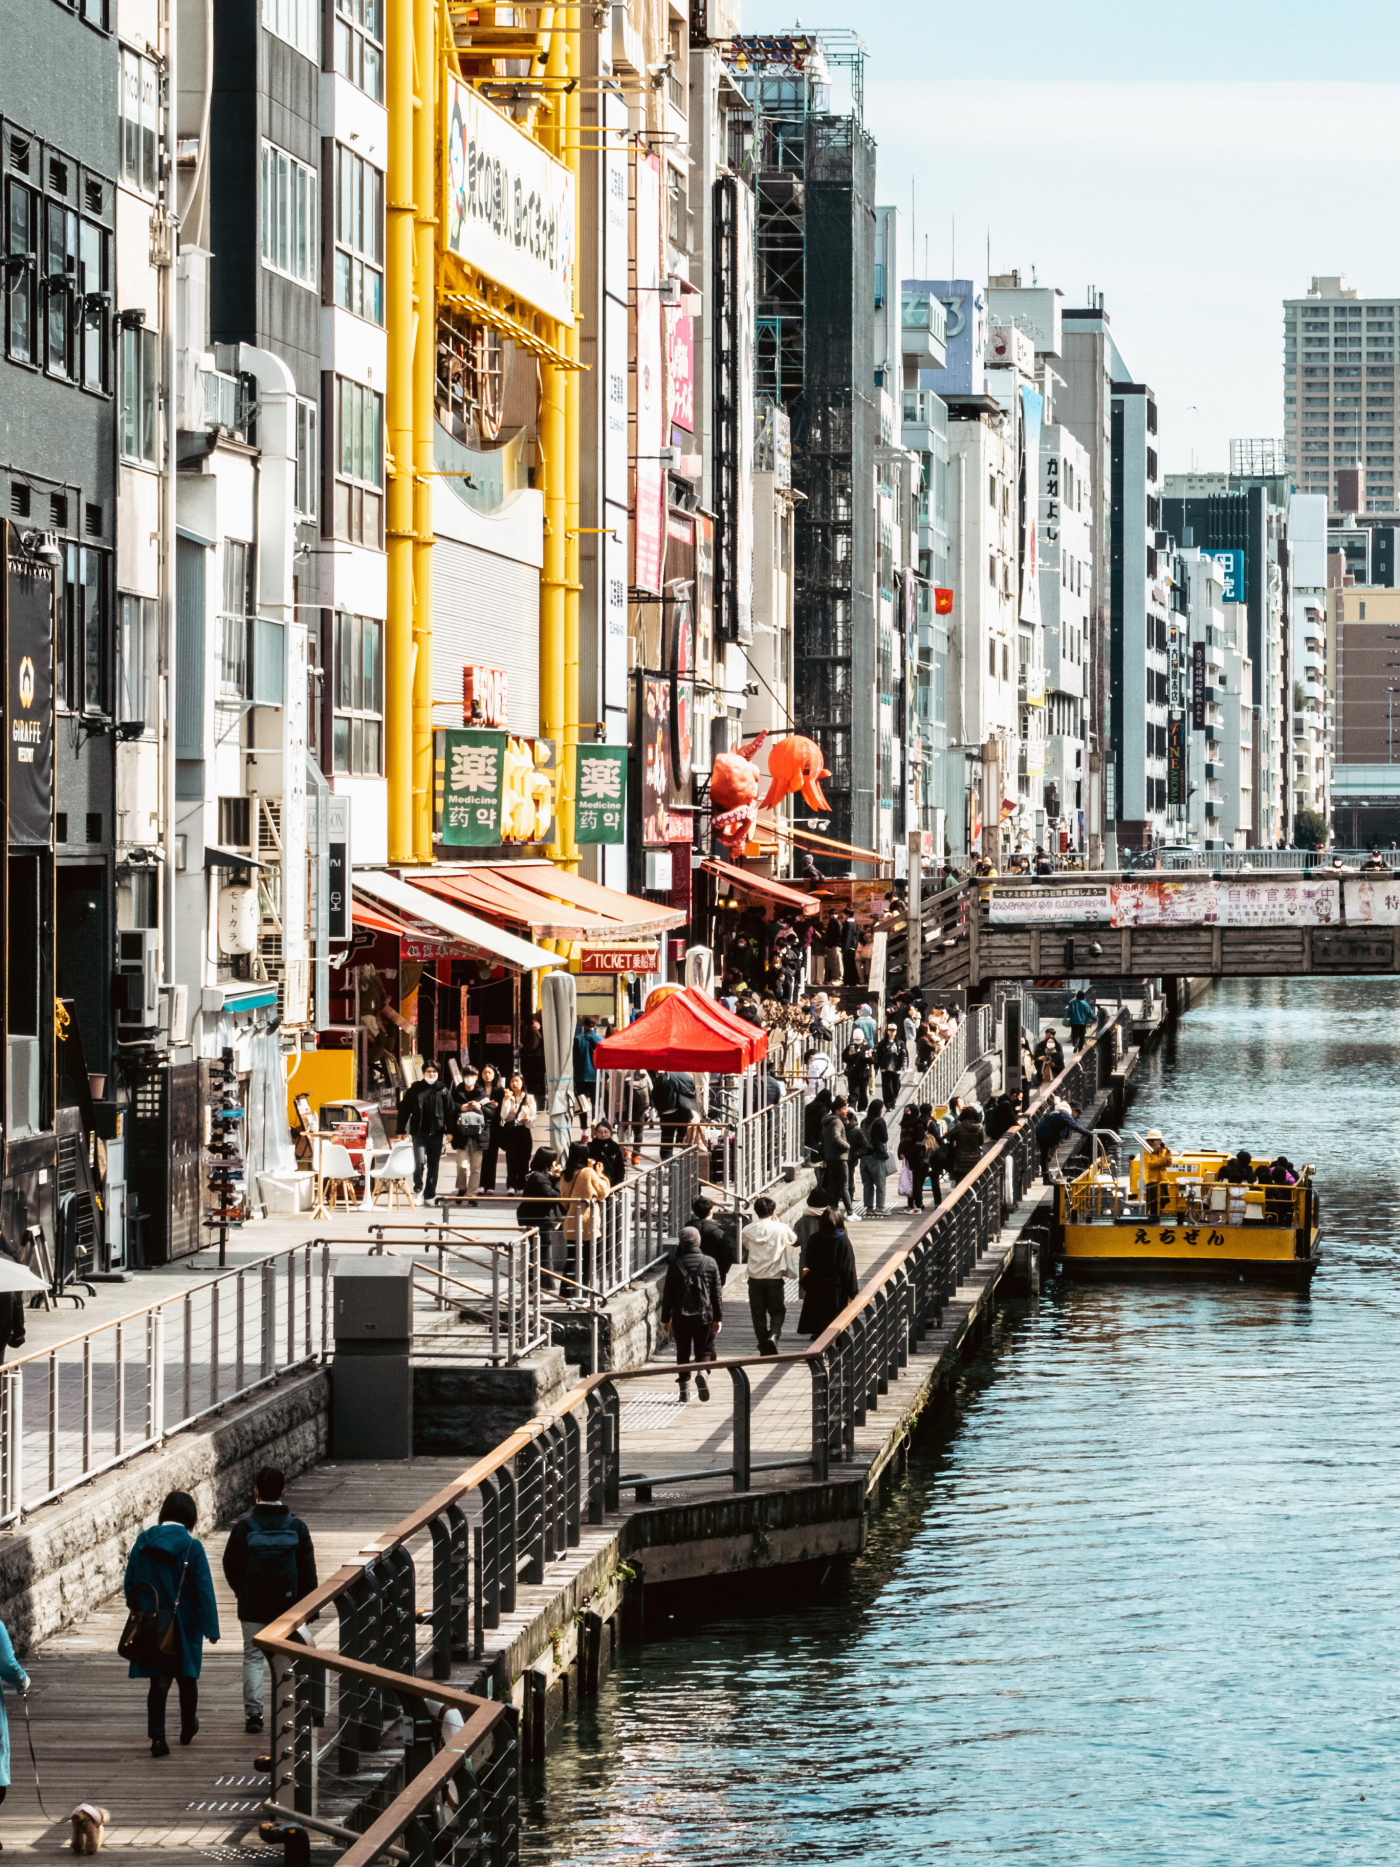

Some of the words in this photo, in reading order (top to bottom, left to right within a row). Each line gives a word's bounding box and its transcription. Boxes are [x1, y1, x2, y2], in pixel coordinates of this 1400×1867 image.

[1047, 458, 1058, 541] かねよし
[13, 719, 41, 743] GIRAFFE
[1169, 723, 1181, 769] FINE
[451, 745, 498, 792] 薬
[581, 758, 621, 798] 薬
[449, 795, 497, 804] Medicine
[580, 801, 621, 809] Medicine
[449, 806, 470, 828] 药
[476, 808, 497, 829] 약
[580, 811, 598, 829] 药
[603, 812, 620, 830] 약
[330, 859, 341, 867] PM
[676, 847, 687, 890] ラーメン
[1228, 886, 1334, 902] 自衛官募集中
[229, 891, 238, 942] モトカラ
[594, 953, 632, 969] TICKET
[1134, 1228, 1224, 1246] えちぜん
